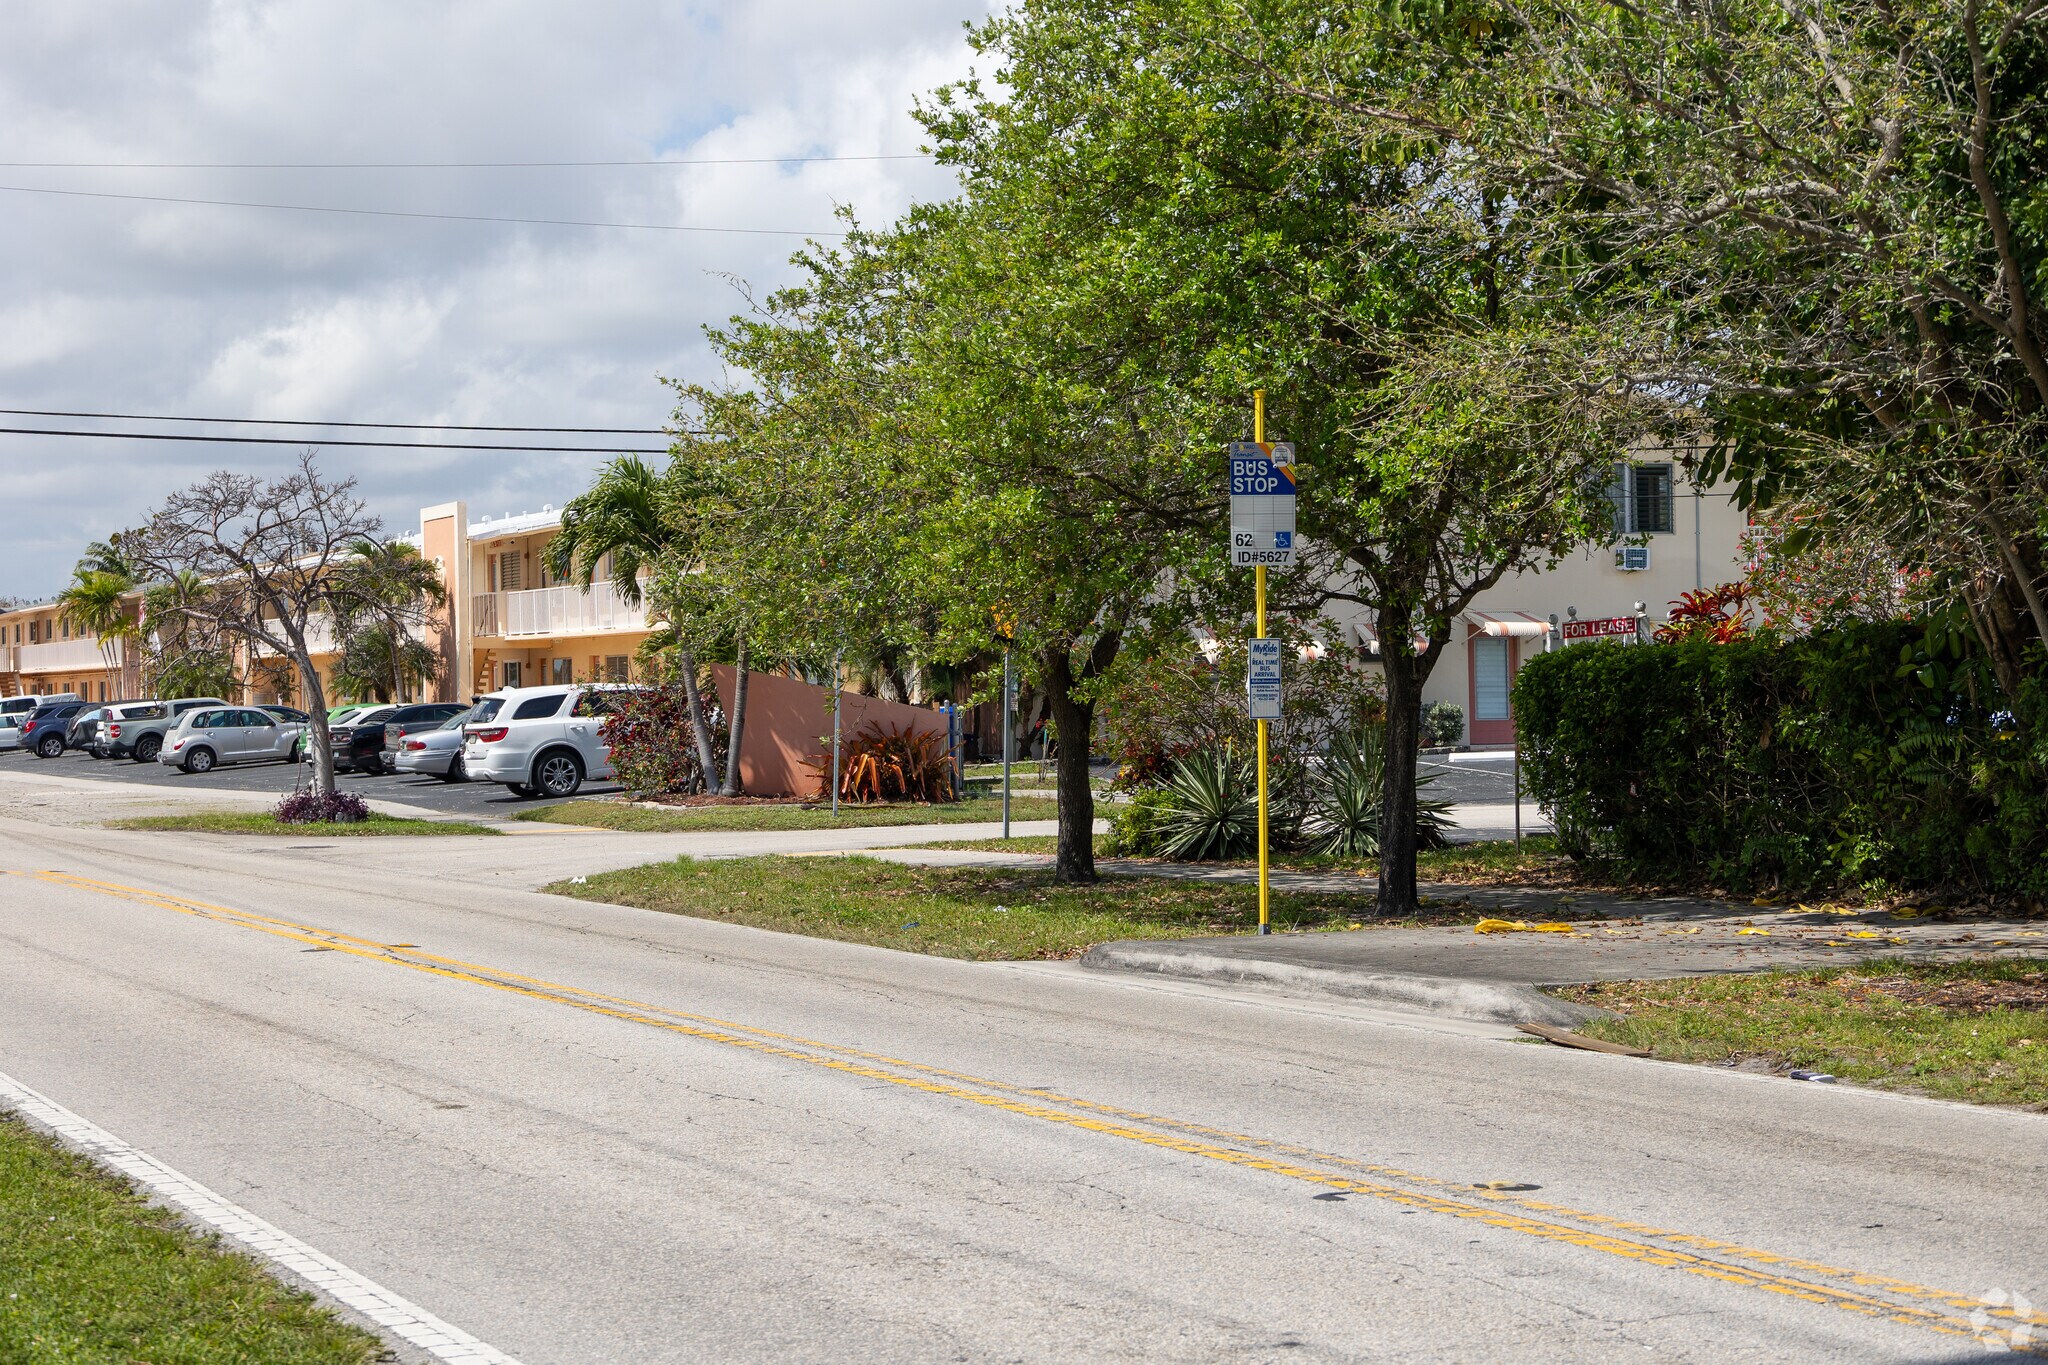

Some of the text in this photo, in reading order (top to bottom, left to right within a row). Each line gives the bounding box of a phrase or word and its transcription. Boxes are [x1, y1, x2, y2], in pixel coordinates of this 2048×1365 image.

[1233, 460, 1268, 476] BUS
[1233, 477, 1278, 493] STOP
[1235, 533, 1253, 547] 62
[1238, 551, 1290, 563] ID#5627
[1564, 619, 1633, 637] FOR LEASE
[1253, 644, 1277, 654] MyRide
